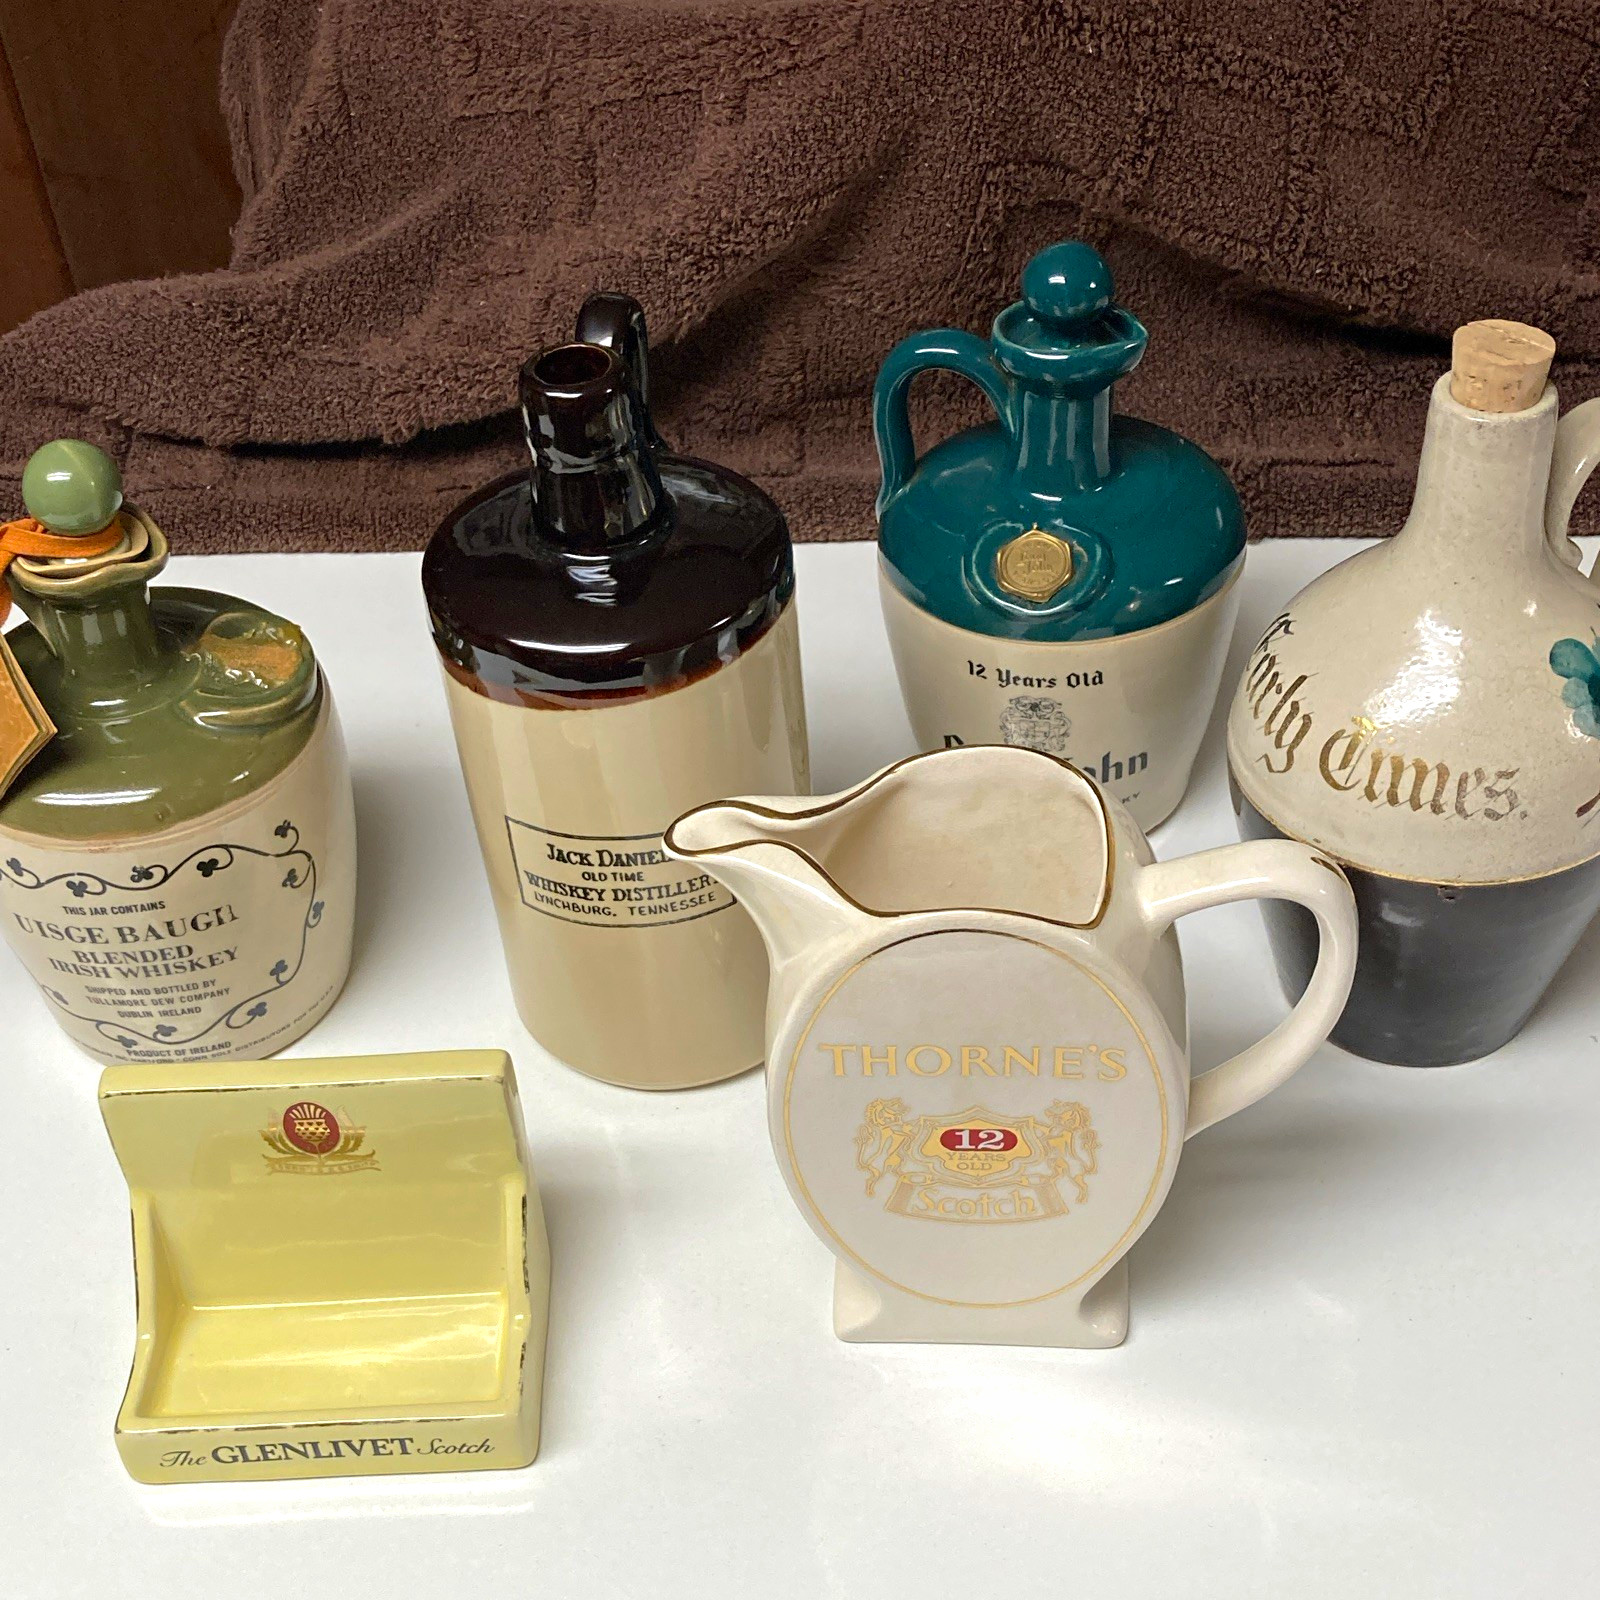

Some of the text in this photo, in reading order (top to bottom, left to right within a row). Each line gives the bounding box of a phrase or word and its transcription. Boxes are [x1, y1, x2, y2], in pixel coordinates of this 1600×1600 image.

[967, 660, 1104, 688] 12 Years Old
[546, 843, 594, 867] JACK
[524, 870, 720, 902] WHISKEY DISTILLER
[581, 871, 644, 882] OLD TIME
[62, 900, 166, 916] THIS JAR CONTAINS
[628, 891, 717, 916] TENNESSEE
[13, 904, 239, 945] UISGE BAUGH
[48, 946, 239, 979] IRISH WHISKEY
[72, 944, 194, 965] BLENDED
[84, 979, 217, 996] SHIPPED AND BOTTLED BY
[85, 987, 231, 1007] TULLAMORE DEW COMPANY
[117, 1006, 202, 1019] DUBLIN IRELAND
[126, 1041, 232, 1058] PRODUCT OF IRELAND
[819, 1043, 1128, 1082] THORNE'S
[954, 1129, 1005, 1150] 12
[945, 1151, 1006, 1162] YEARS
[956, 1160, 993, 1172] OLD
[912, 1186, 1037, 1219] Scotch
[160, 1437, 496, 1468] The GLENLIVET Scotch
